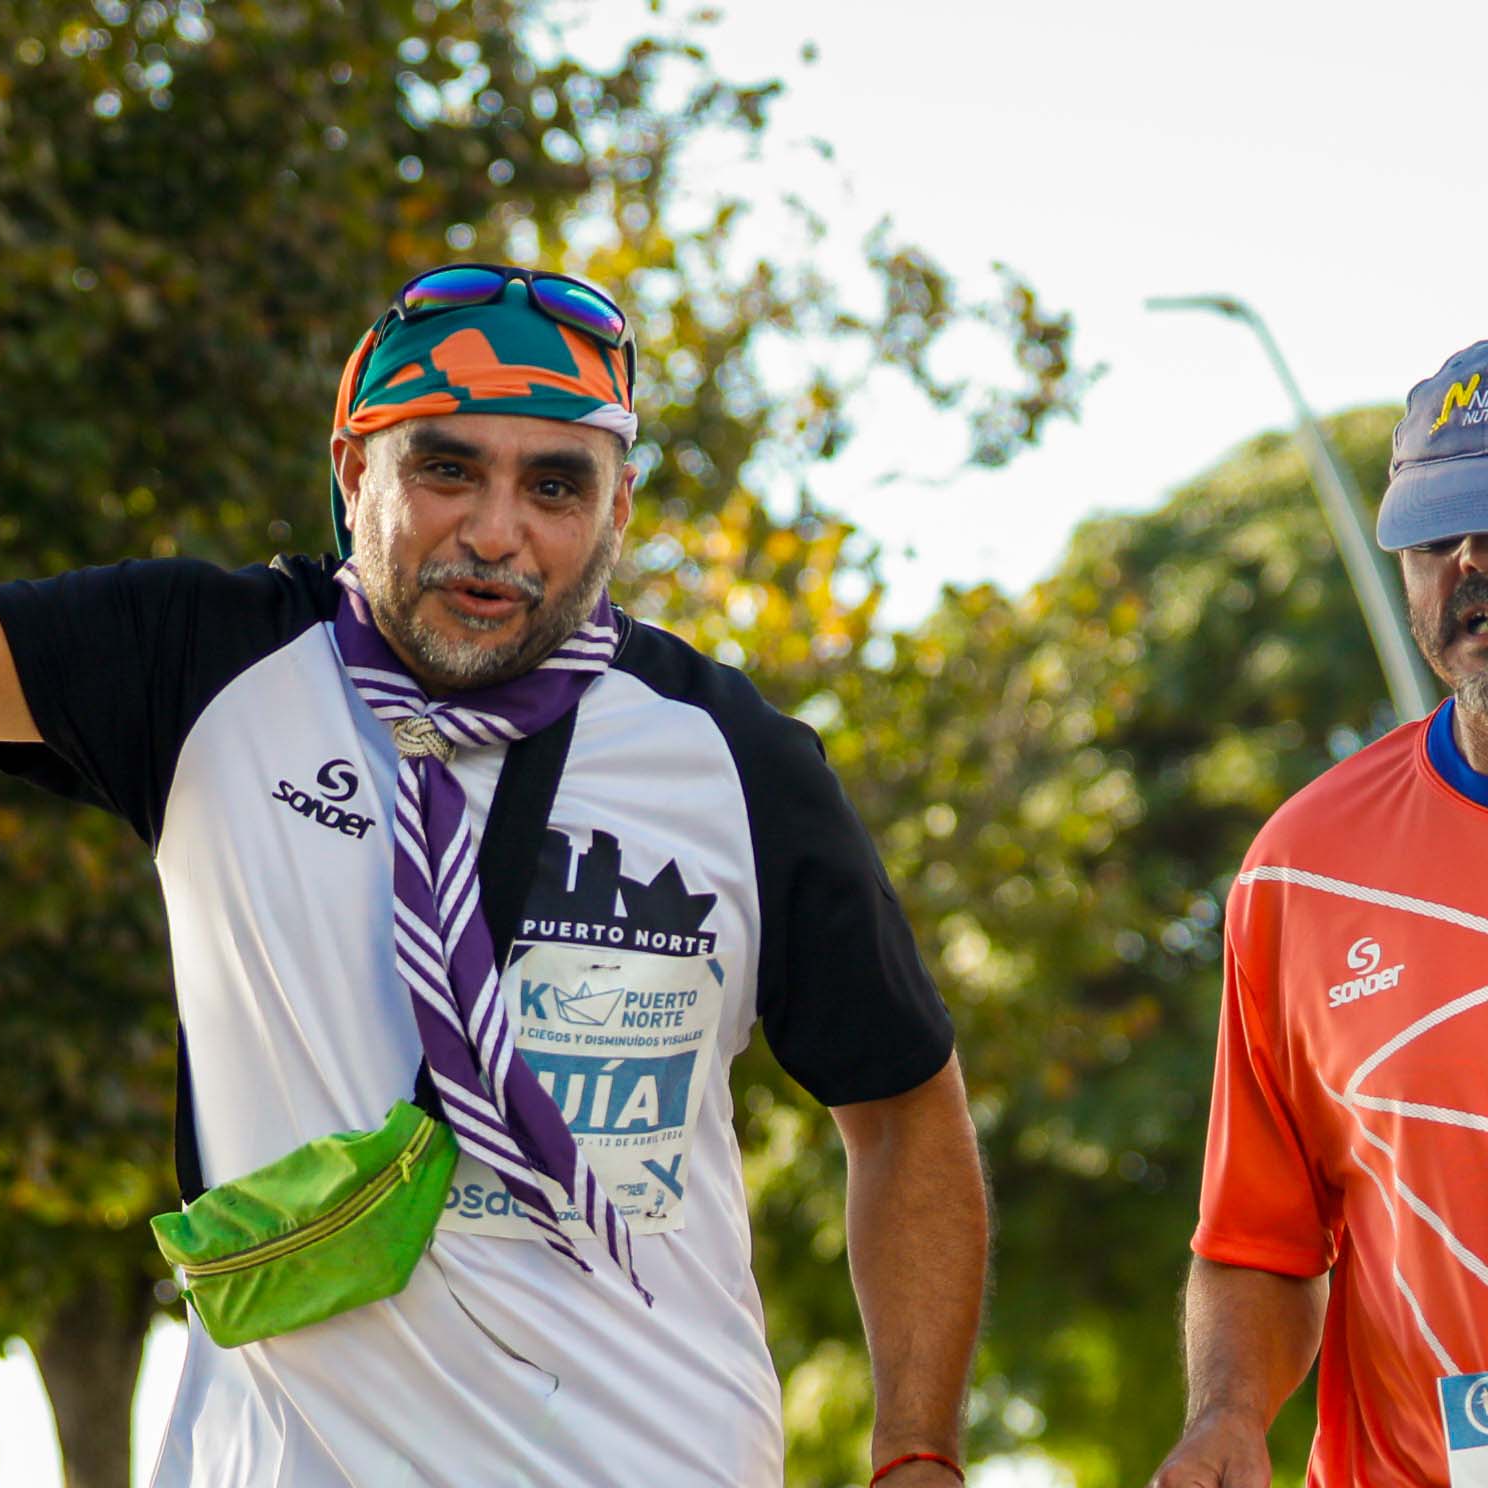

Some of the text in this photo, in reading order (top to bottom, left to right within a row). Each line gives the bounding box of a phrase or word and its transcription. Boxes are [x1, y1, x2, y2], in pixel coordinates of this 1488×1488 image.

[523, 919, 711, 955] PUERTO NORTE
[625, 990, 698, 1009] PUERTO
[621, 1011, 685, 1028] NORTE
[528, 1028, 571, 1044] CIEGOS
[575, 1033, 583, 1044] Y
[663, 1029, 705, 1046] VISUALES
[538, 1059, 660, 1129] UÍA
[615, 1138, 629, 1147] DE
[632, 1135, 659, 1146] ABRIL
